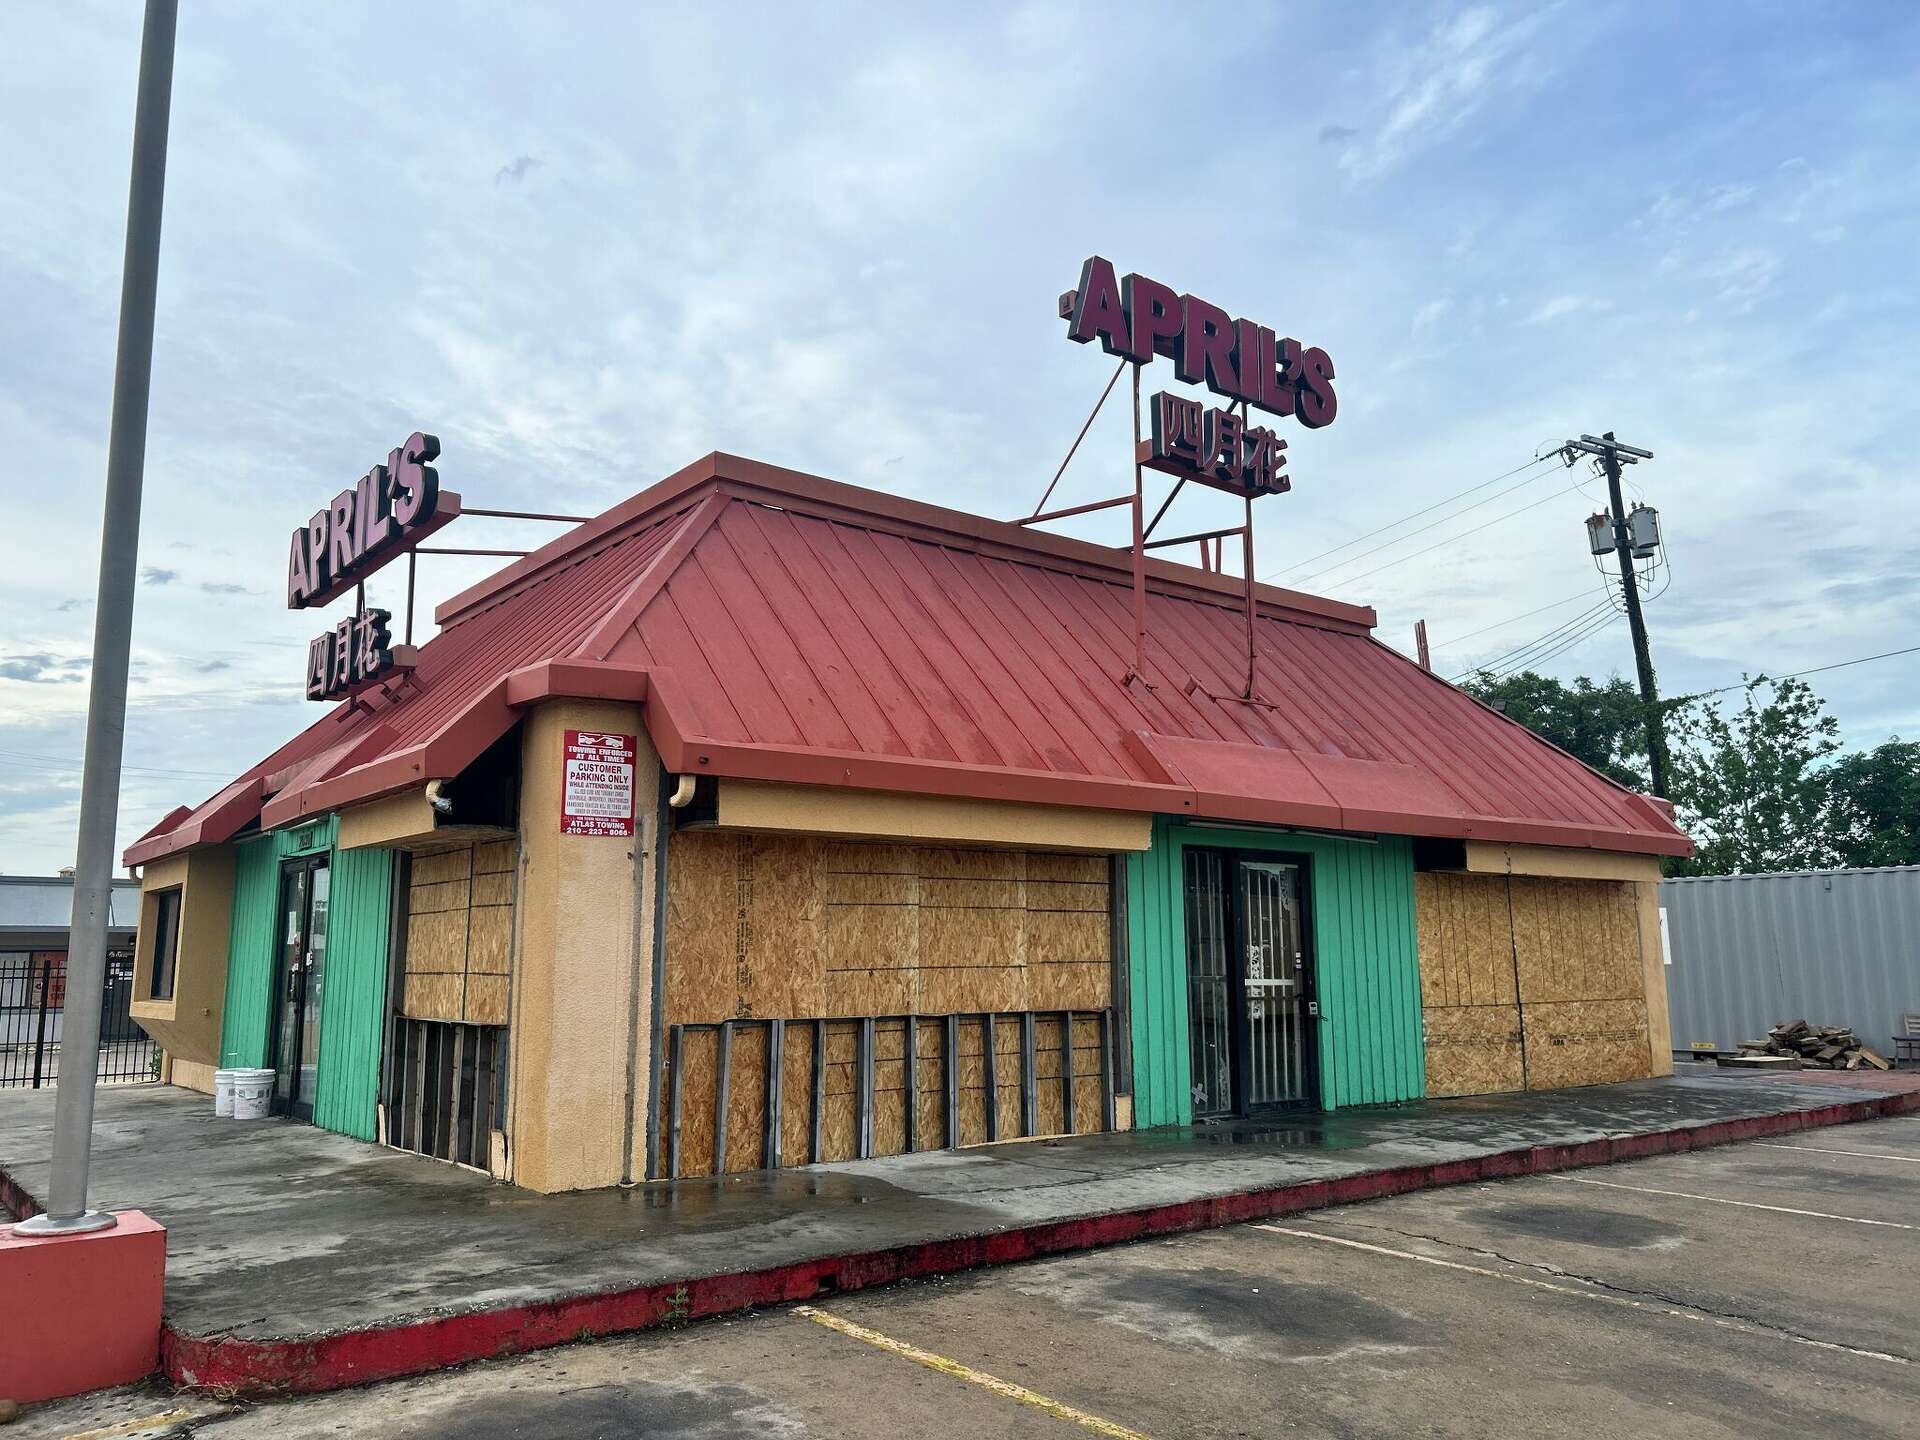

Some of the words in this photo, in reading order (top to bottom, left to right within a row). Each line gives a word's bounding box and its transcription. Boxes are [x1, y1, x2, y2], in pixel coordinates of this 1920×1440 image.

[1067, 255, 1338, 429] APRIL'S
[1150, 390, 1291, 494] 四月花
[288, 431, 441, 608] APRIL'S
[307, 607, 392, 700] 四月花
[568, 746, 597, 754] TOWING
[599, 749, 633, 757] ENFORCED
[570, 772, 606, 783] PARKING
[608, 775, 629, 784] ONLY
[578, 763, 622, 774] CUSTOMER
